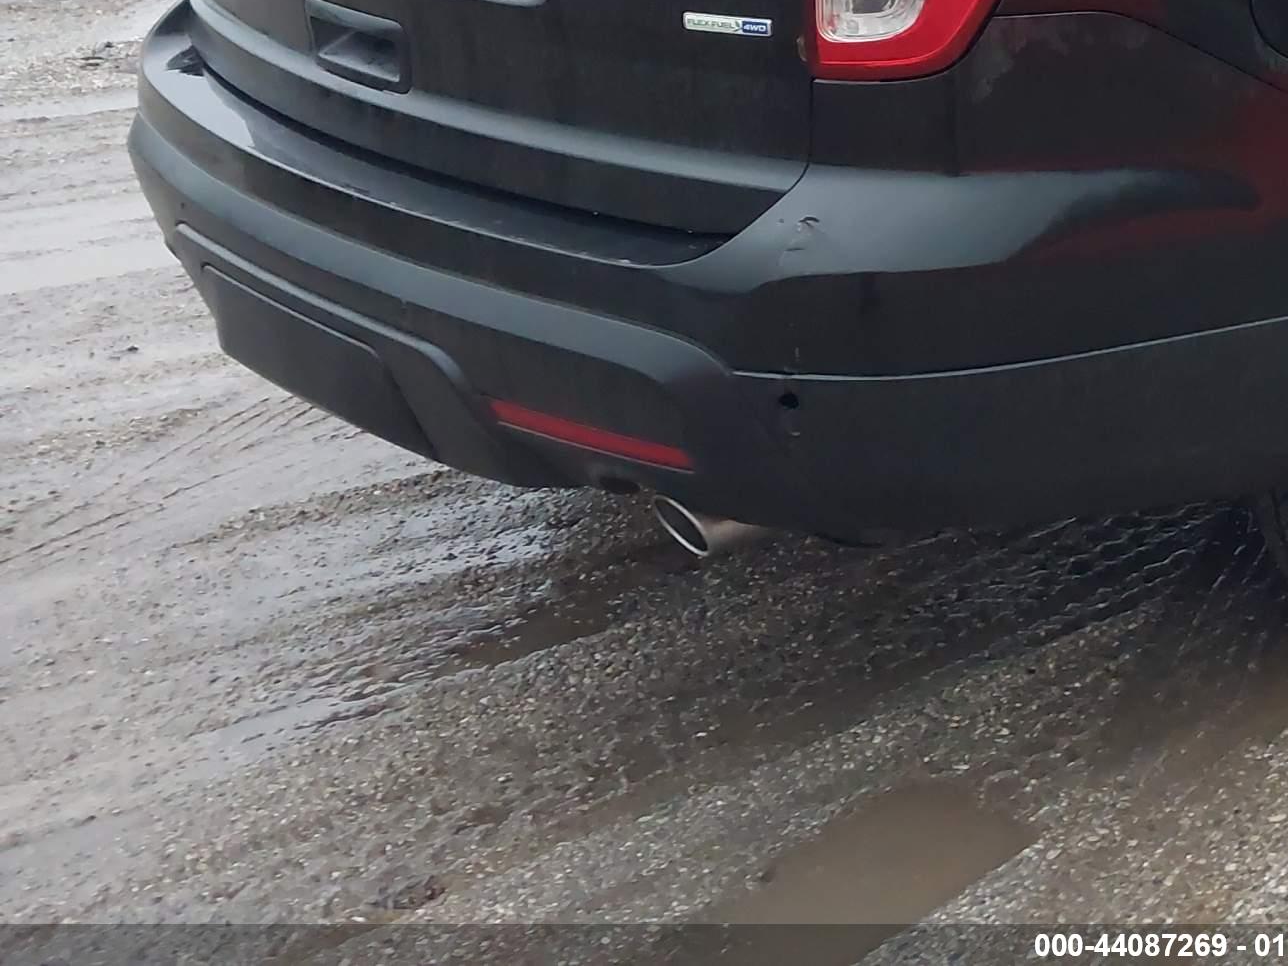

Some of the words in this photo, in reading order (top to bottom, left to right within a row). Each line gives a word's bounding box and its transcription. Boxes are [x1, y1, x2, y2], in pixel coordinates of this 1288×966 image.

[687, 18, 709, 27] FLEX
[711, 20, 735, 29] FUEL
[743, 23, 767, 32] 4WD
